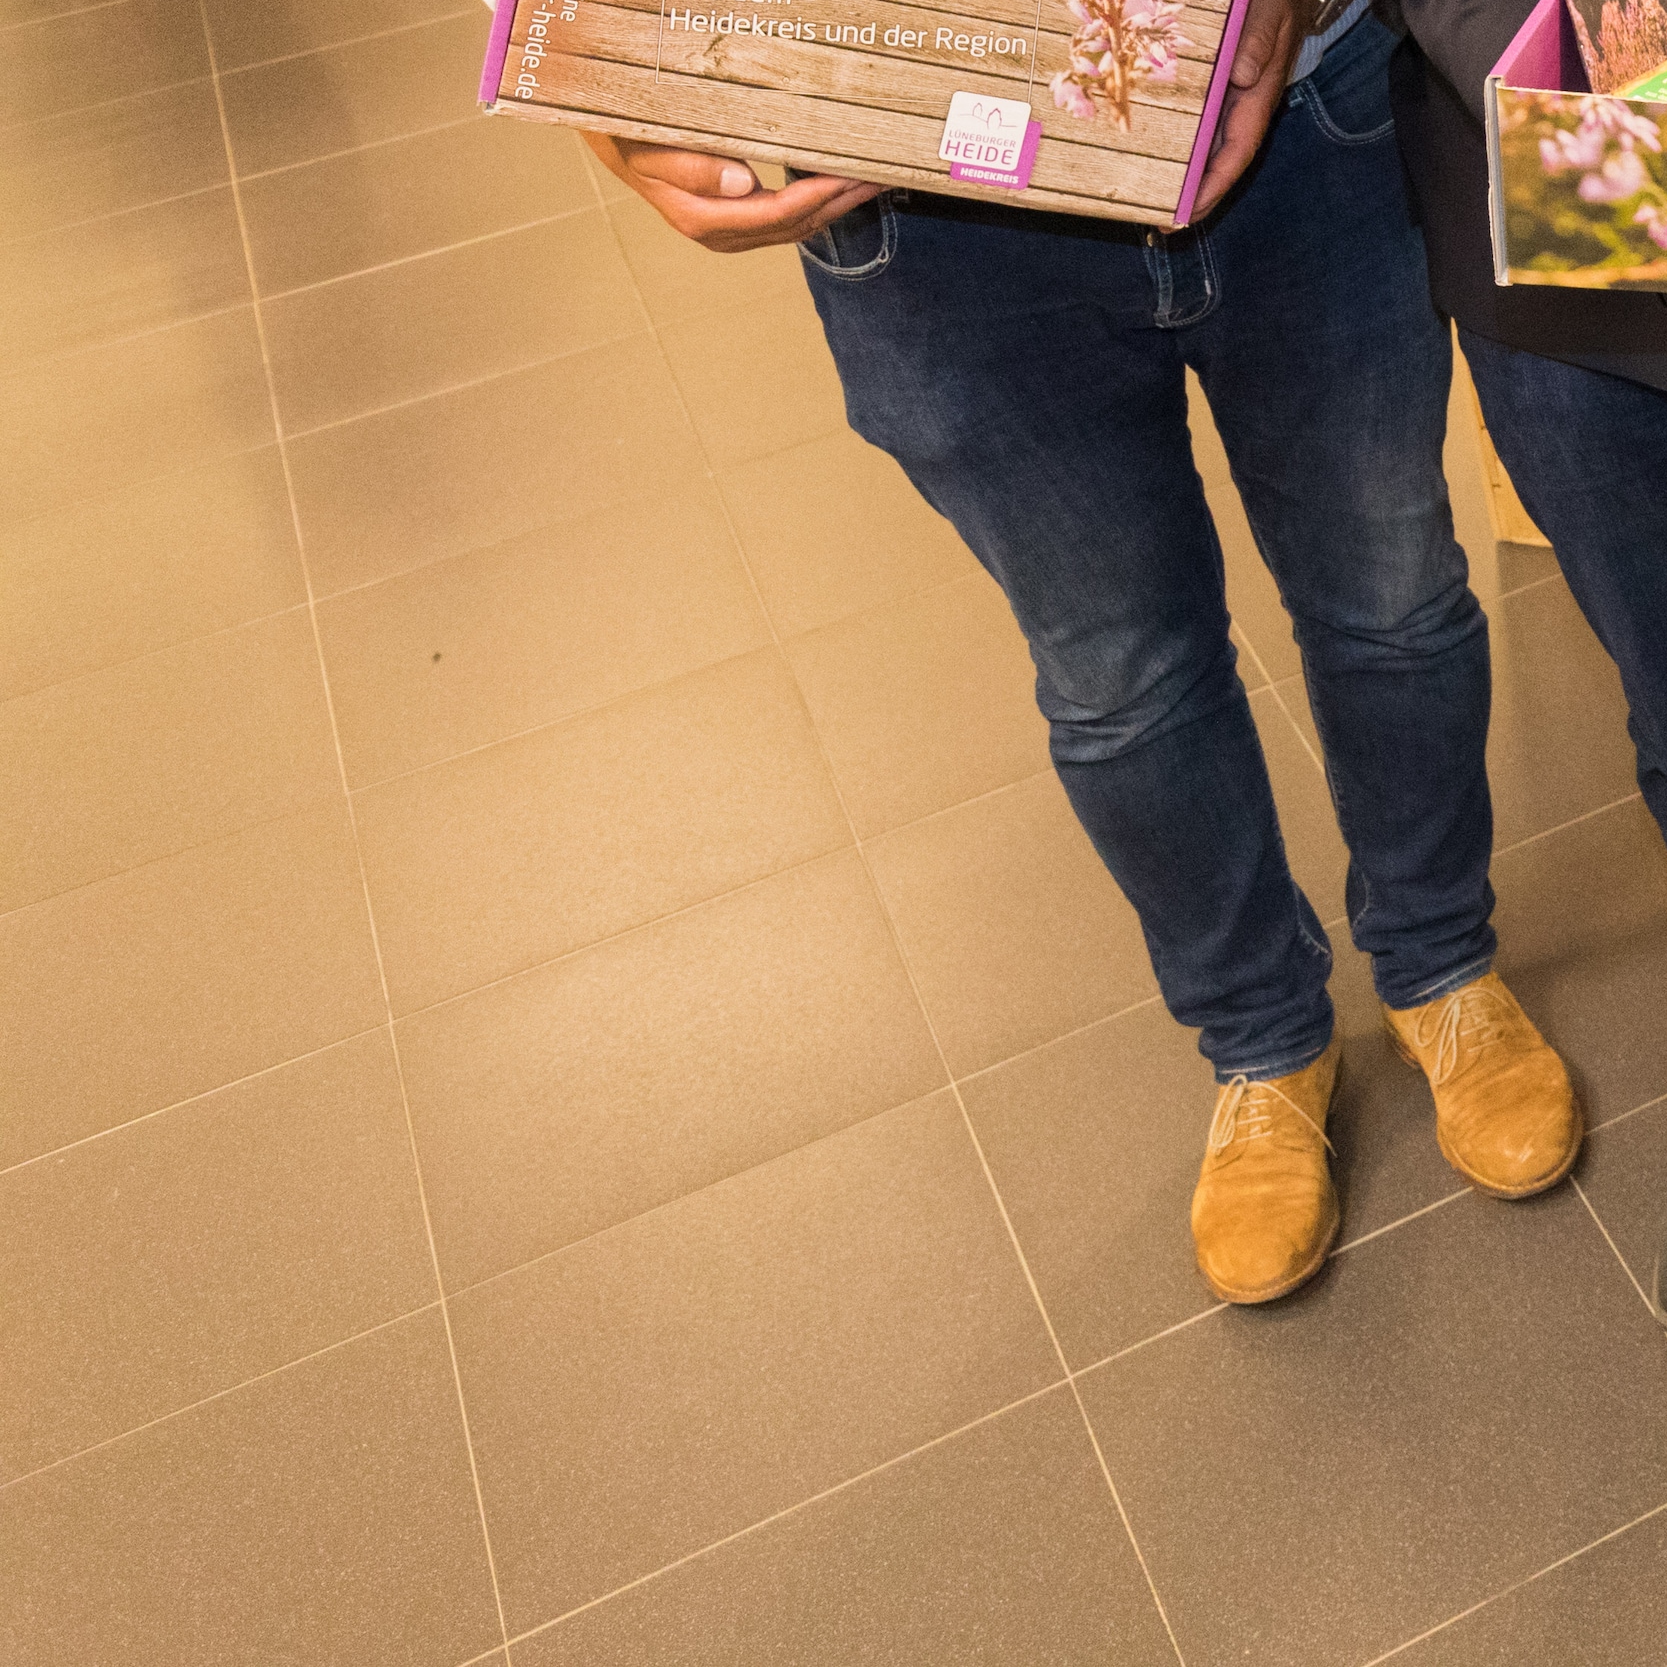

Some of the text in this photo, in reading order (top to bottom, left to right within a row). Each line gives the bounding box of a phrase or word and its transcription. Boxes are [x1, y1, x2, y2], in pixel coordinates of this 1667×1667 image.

[669, 7, 1028, 58] Heidekreis und der Region
[947, 129, 1017, 149] LÜNEBURGER
[944, 140, 1015, 166] HEIDE
[959, 166, 1020, 185] HEIDEKREIS
